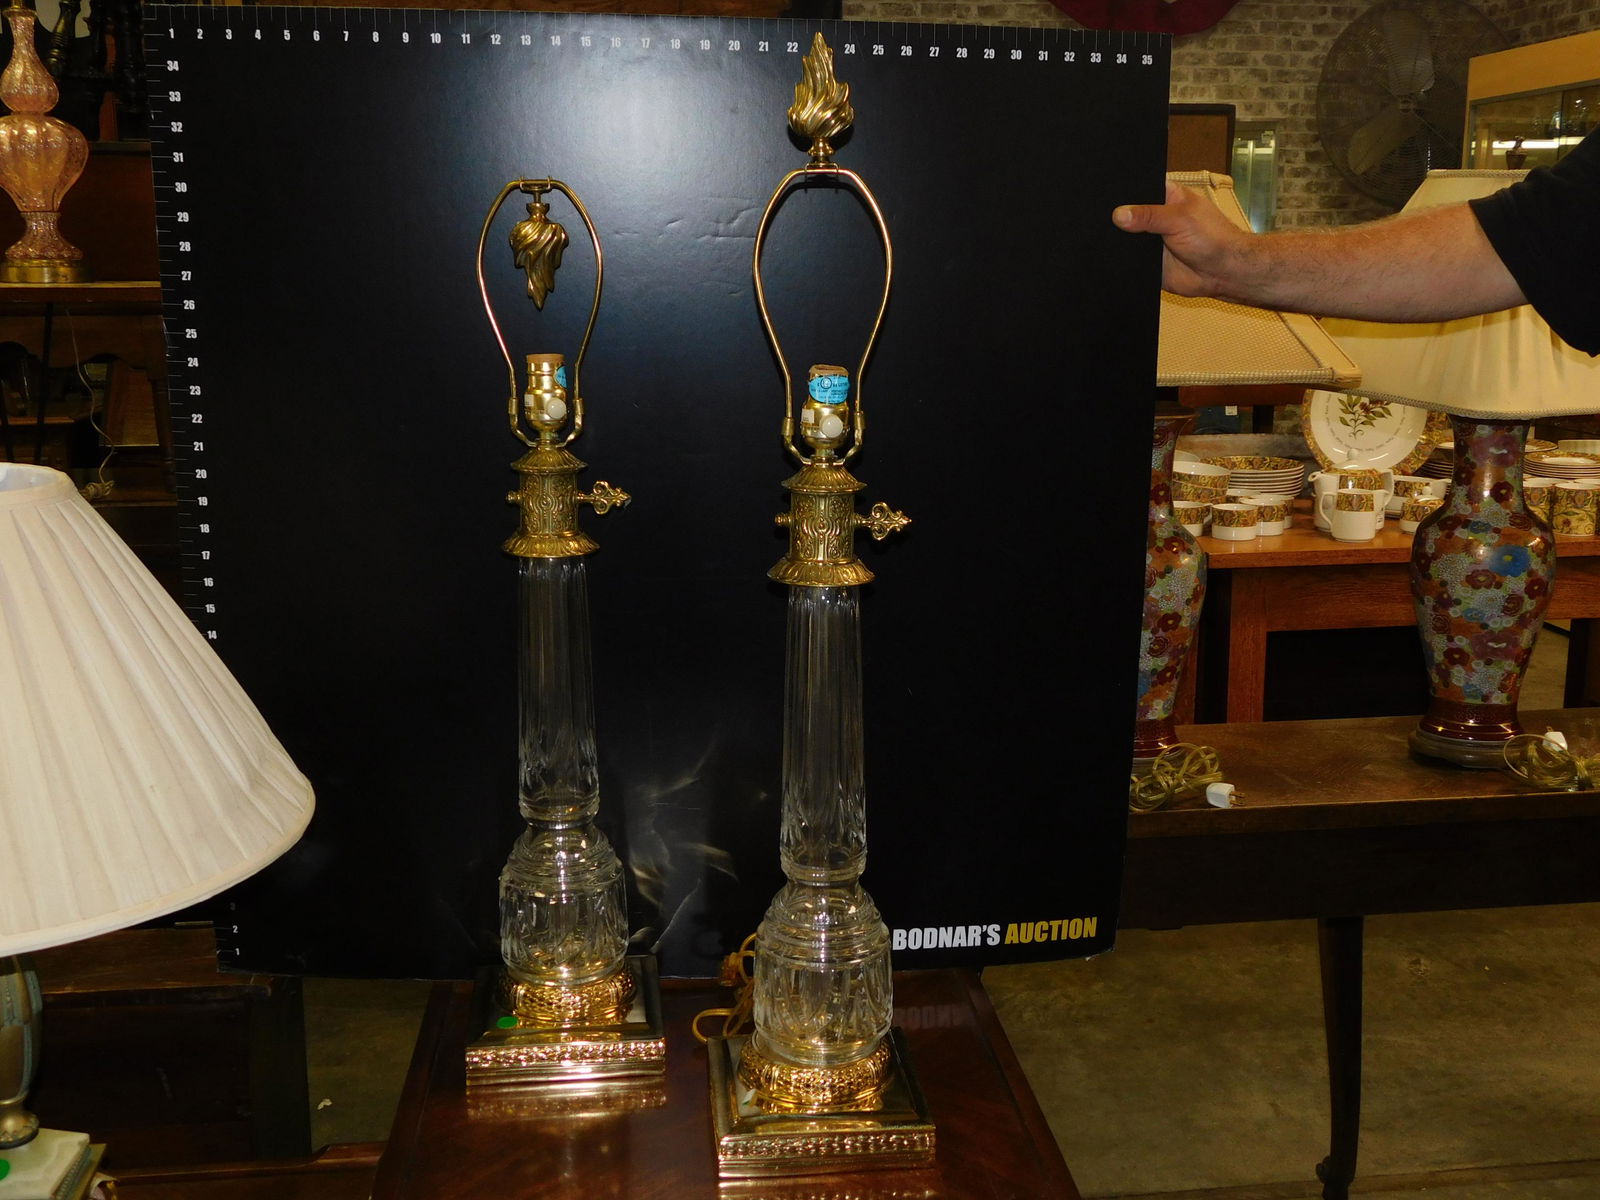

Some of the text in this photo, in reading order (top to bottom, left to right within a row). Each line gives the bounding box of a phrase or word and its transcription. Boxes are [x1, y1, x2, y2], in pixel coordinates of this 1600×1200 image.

[168, 28, 1152, 64] 1 2 3 4 5 6 7 8 9 10 11 12 13 14 15 16 17 18 19 20 21 22 24 25 26 27 28 29 30 31 32 33 34 35
[166, 60, 180, 72] 34
[168, 90, 182, 102] 33
[170, 122, 182, 132] 32
[172, 152, 184, 162] 31
[174, 182, 188, 192] 30
[178, 212, 190, 222] 29
[180, 242, 190, 252] 28
[182, 270, 192, 280] 27
[184, 300, 196, 310] 26
[186, 328, 198, 338] 25
[188, 358, 198, 368] 24
[190, 386, 200, 396] 23
[192, 414, 202, 424] 22
[194, 442, 204, 452] 21
[196, 468, 206, 478] 20
[198, 496, 208, 506] 19
[200, 524, 210, 534] 18
[202, 550, 210, 560] 17
[204, 578, 214, 586] 16
[206, 604, 216, 614] 15
[207, 630, 217, 640] 14
[232, 925, 239, 934] 2
[892, 916, 1098, 951] BODNAR'S AUCTION
[235, 947, 240, 956] 1
